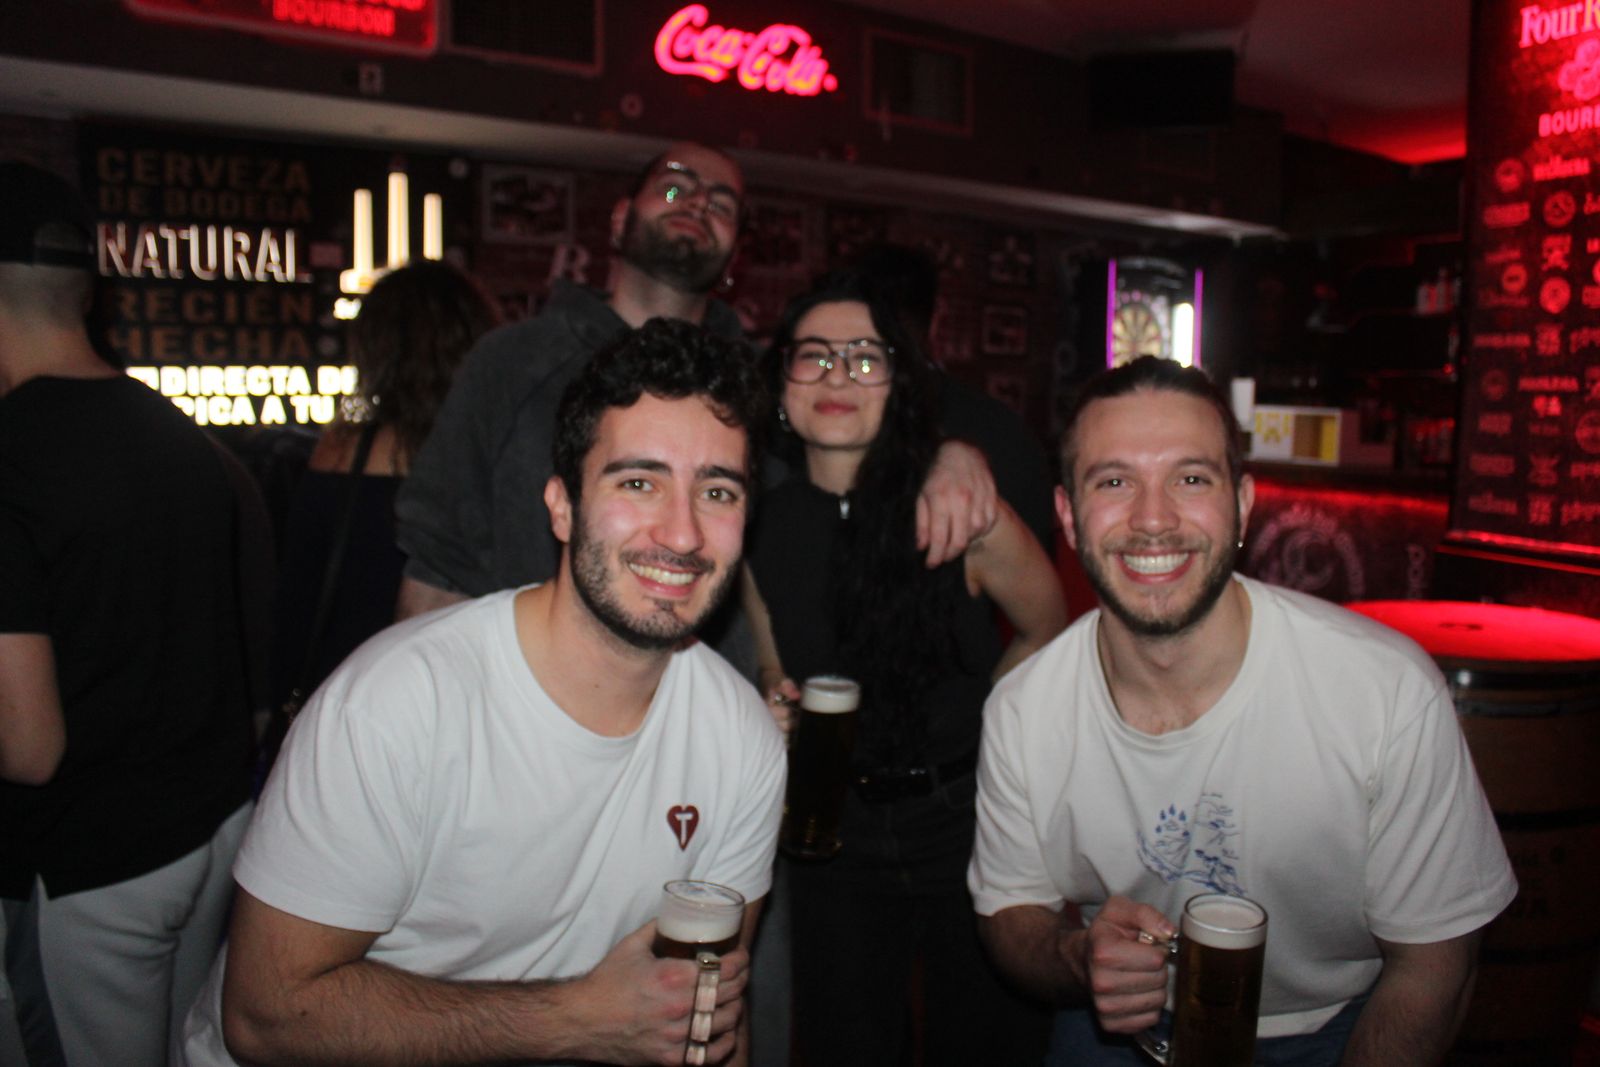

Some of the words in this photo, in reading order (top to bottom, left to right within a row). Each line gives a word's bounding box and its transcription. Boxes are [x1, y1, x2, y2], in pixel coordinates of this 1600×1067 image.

[1518, 3, 1583, 48] Four
[97, 147, 313, 192] CERVEZA
[97, 222, 314, 283] NATURAL
[160, 365, 312, 397] DIRECTA
